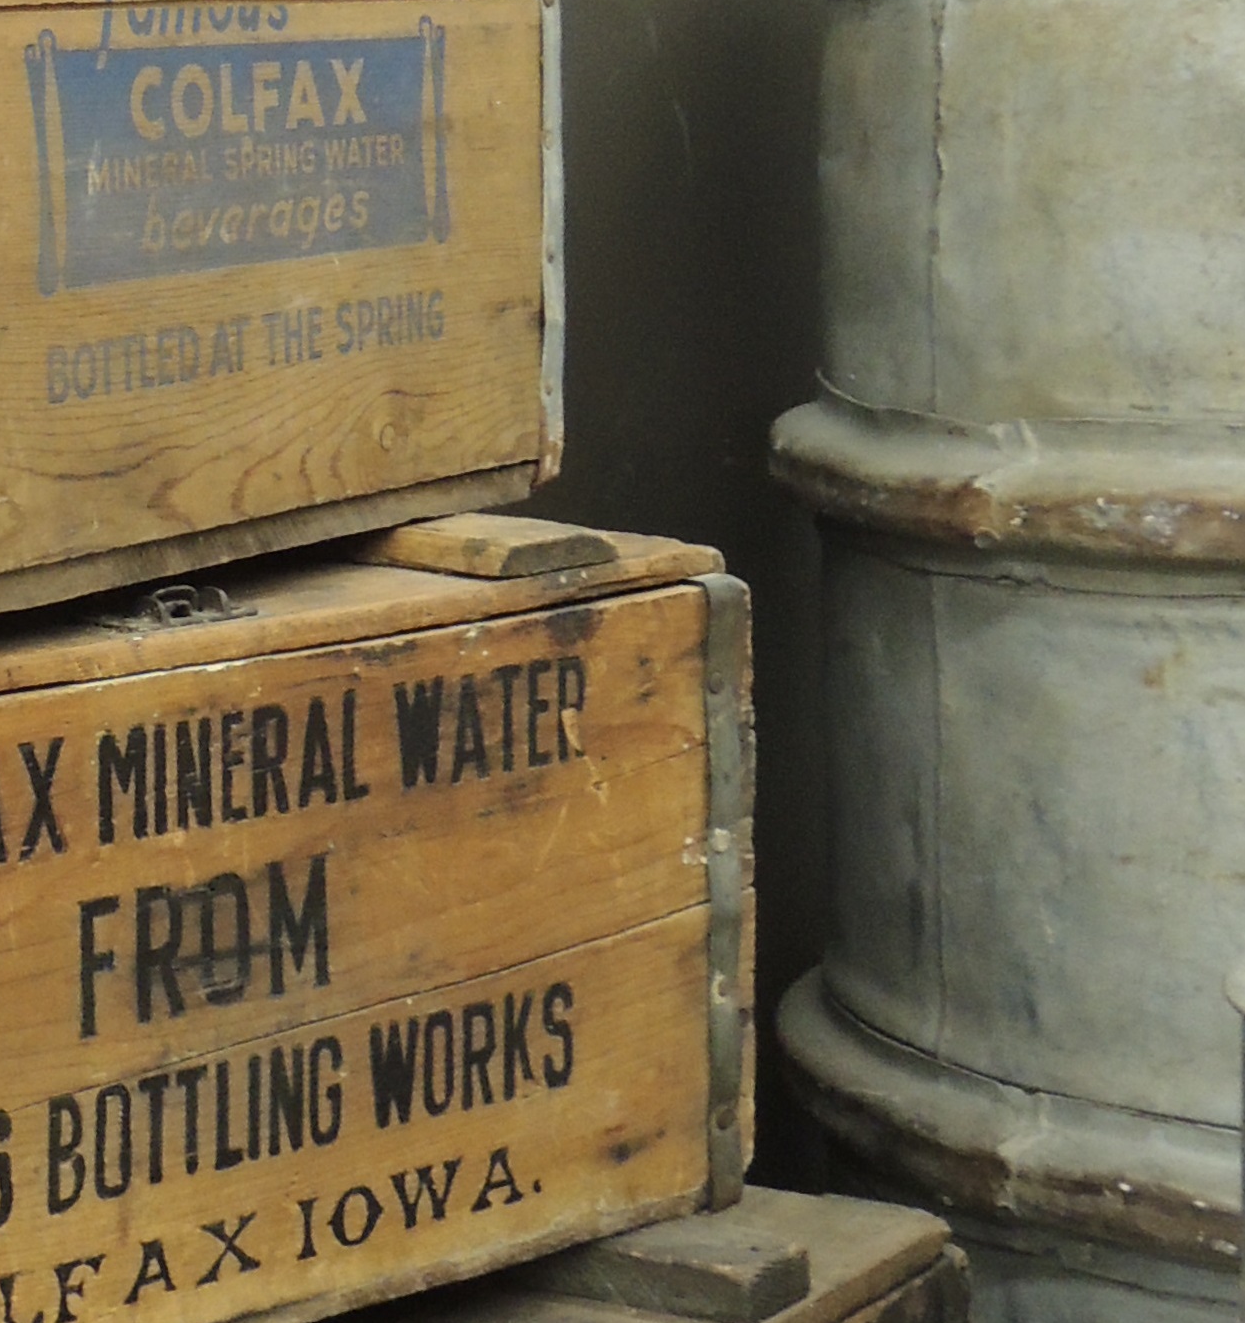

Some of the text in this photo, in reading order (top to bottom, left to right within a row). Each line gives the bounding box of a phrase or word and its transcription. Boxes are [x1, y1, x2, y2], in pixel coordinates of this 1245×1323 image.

[129, 57, 370, 140] COLFAX
[86, 134, 406, 196] MINERAL SPRING WATER
[142, 187, 371, 254] beverages
[46, 289, 446, 404] BOTTLED AT THE SPRING
[96, 687, 370, 846] MINERAL
[391, 655, 588, 791] WATER
[78, 852, 331, 1041] FROM
[46, 1035, 344, 1217] BOTTLING
[368, 980, 576, 1130] WORKS
[296, 1146, 544, 1260] IOWA.
